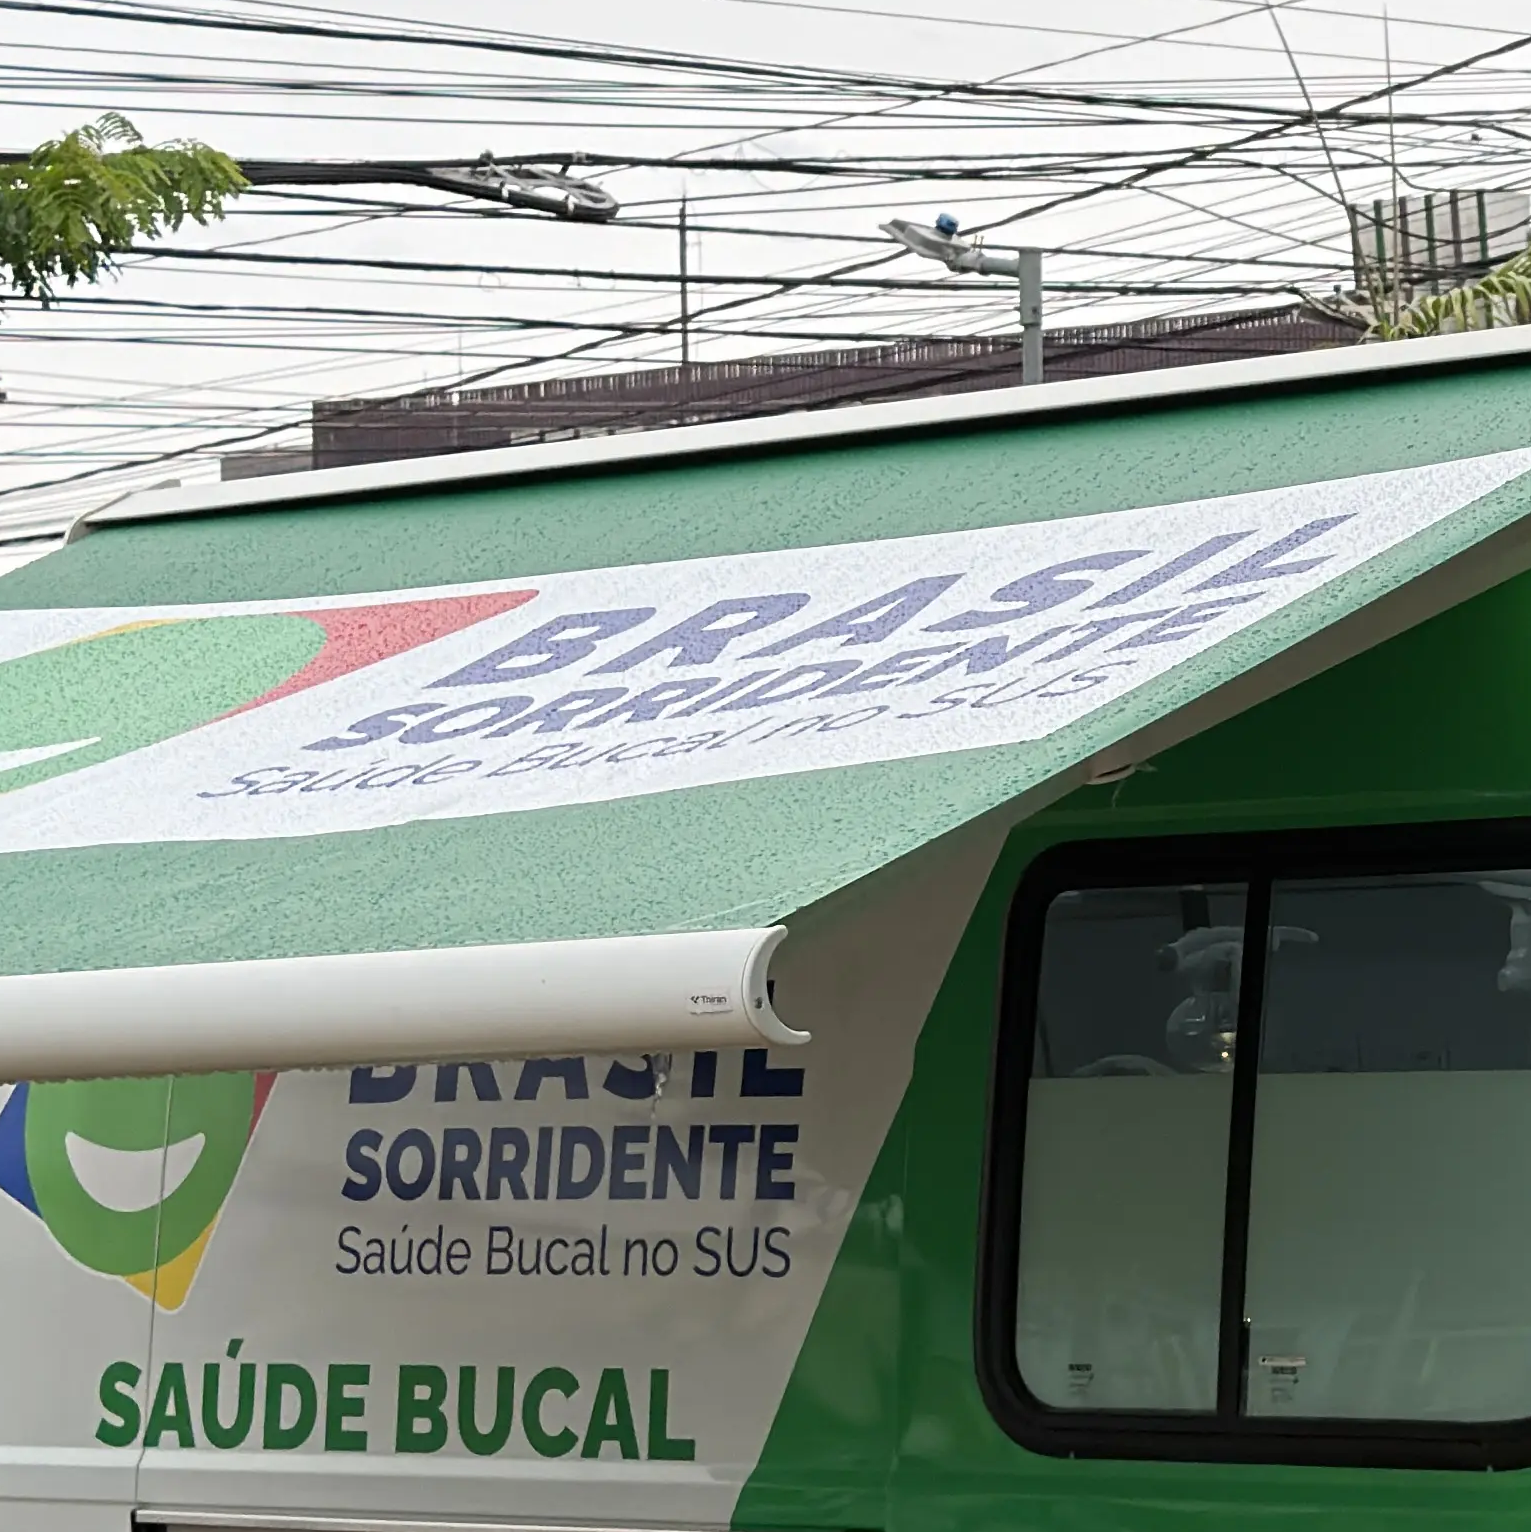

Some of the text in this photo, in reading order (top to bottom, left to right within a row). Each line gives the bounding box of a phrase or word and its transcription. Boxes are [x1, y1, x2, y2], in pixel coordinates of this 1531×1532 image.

[436, 512, 1361, 690] BRASIL
[197, 659, 1138, 798] Saúde Bucal no SUS
[302, 591, 1266, 751] SORRIDENTE
[341, 1124, 799, 1202] SORRIDENTE
[336, 1225, 792, 1278] Saúde Bucal no SUS
[95, 1339, 695, 1461] SAÚDE BUCAL
